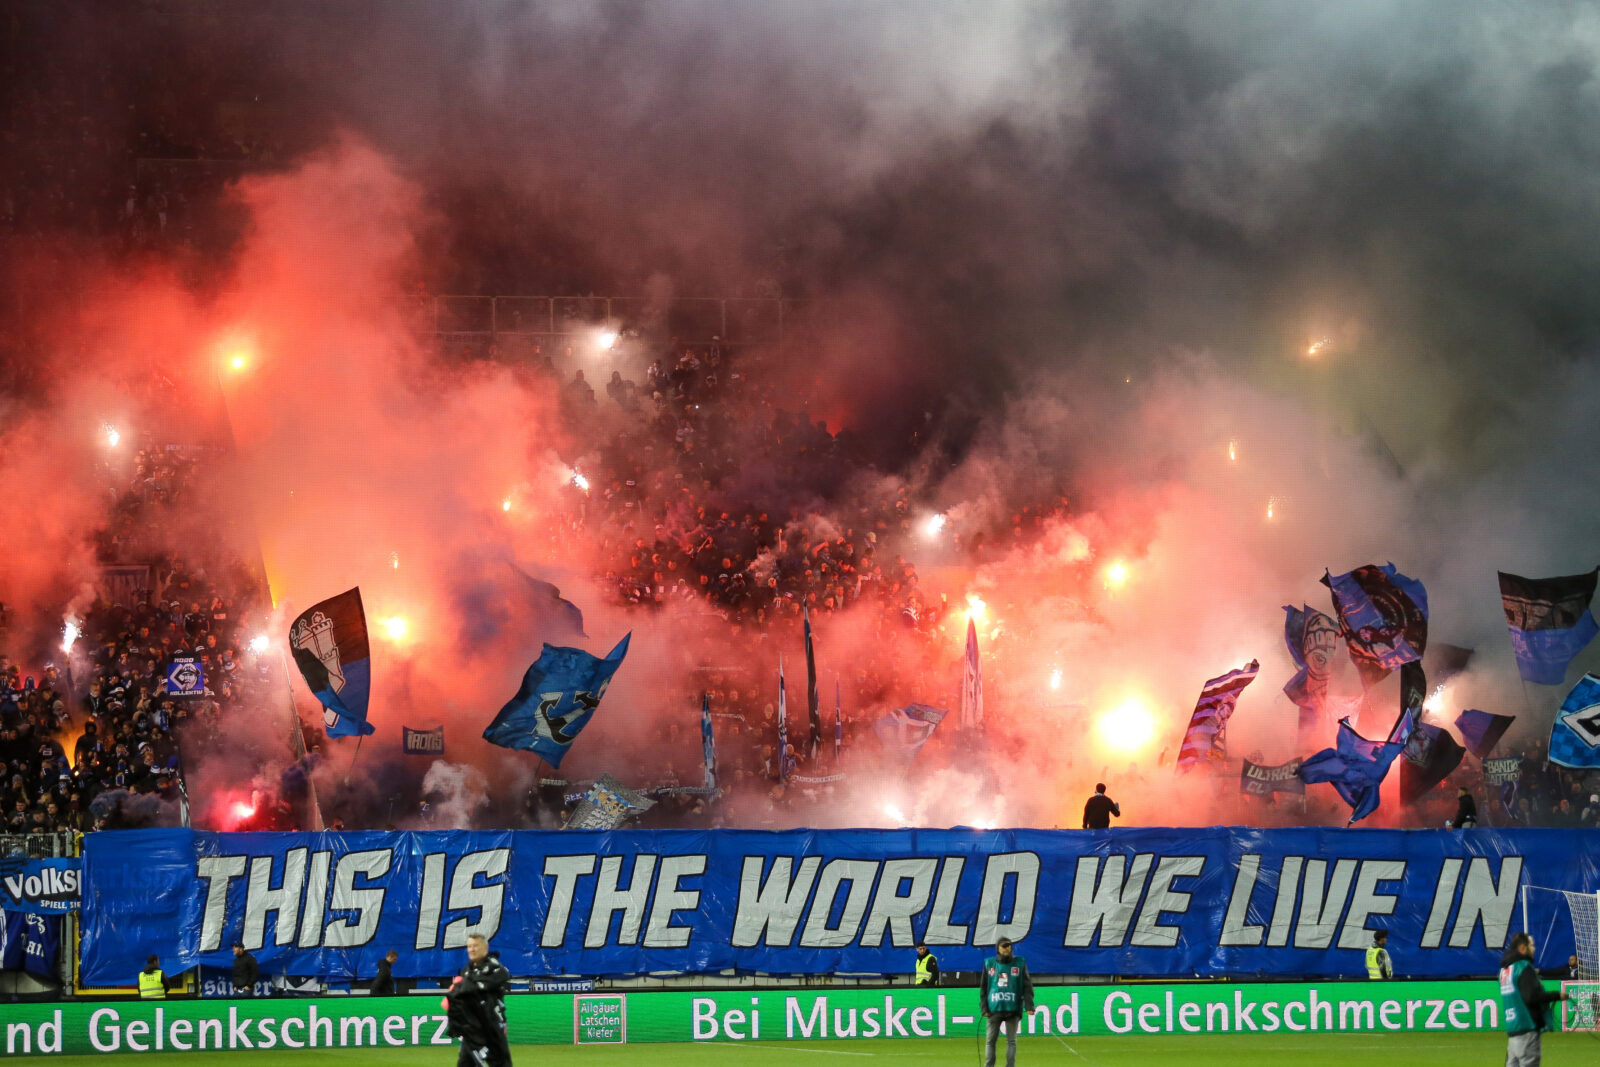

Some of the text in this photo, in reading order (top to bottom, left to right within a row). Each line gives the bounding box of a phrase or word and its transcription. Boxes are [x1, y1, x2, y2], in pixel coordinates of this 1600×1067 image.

[196, 847, 1524, 952] THIS IS THE WORLD WE LIVE IN
[581, 1002, 619, 1016] Allgäuer
[991, 992, 1016, 1002] HOST
[89, 1005, 463, 1052] Gelenkschmerz
[580, 1014, 620, 1026] Latschen
[692, 989, 1498, 1040] Bei Muskel- nd Gelenkschmerzen
